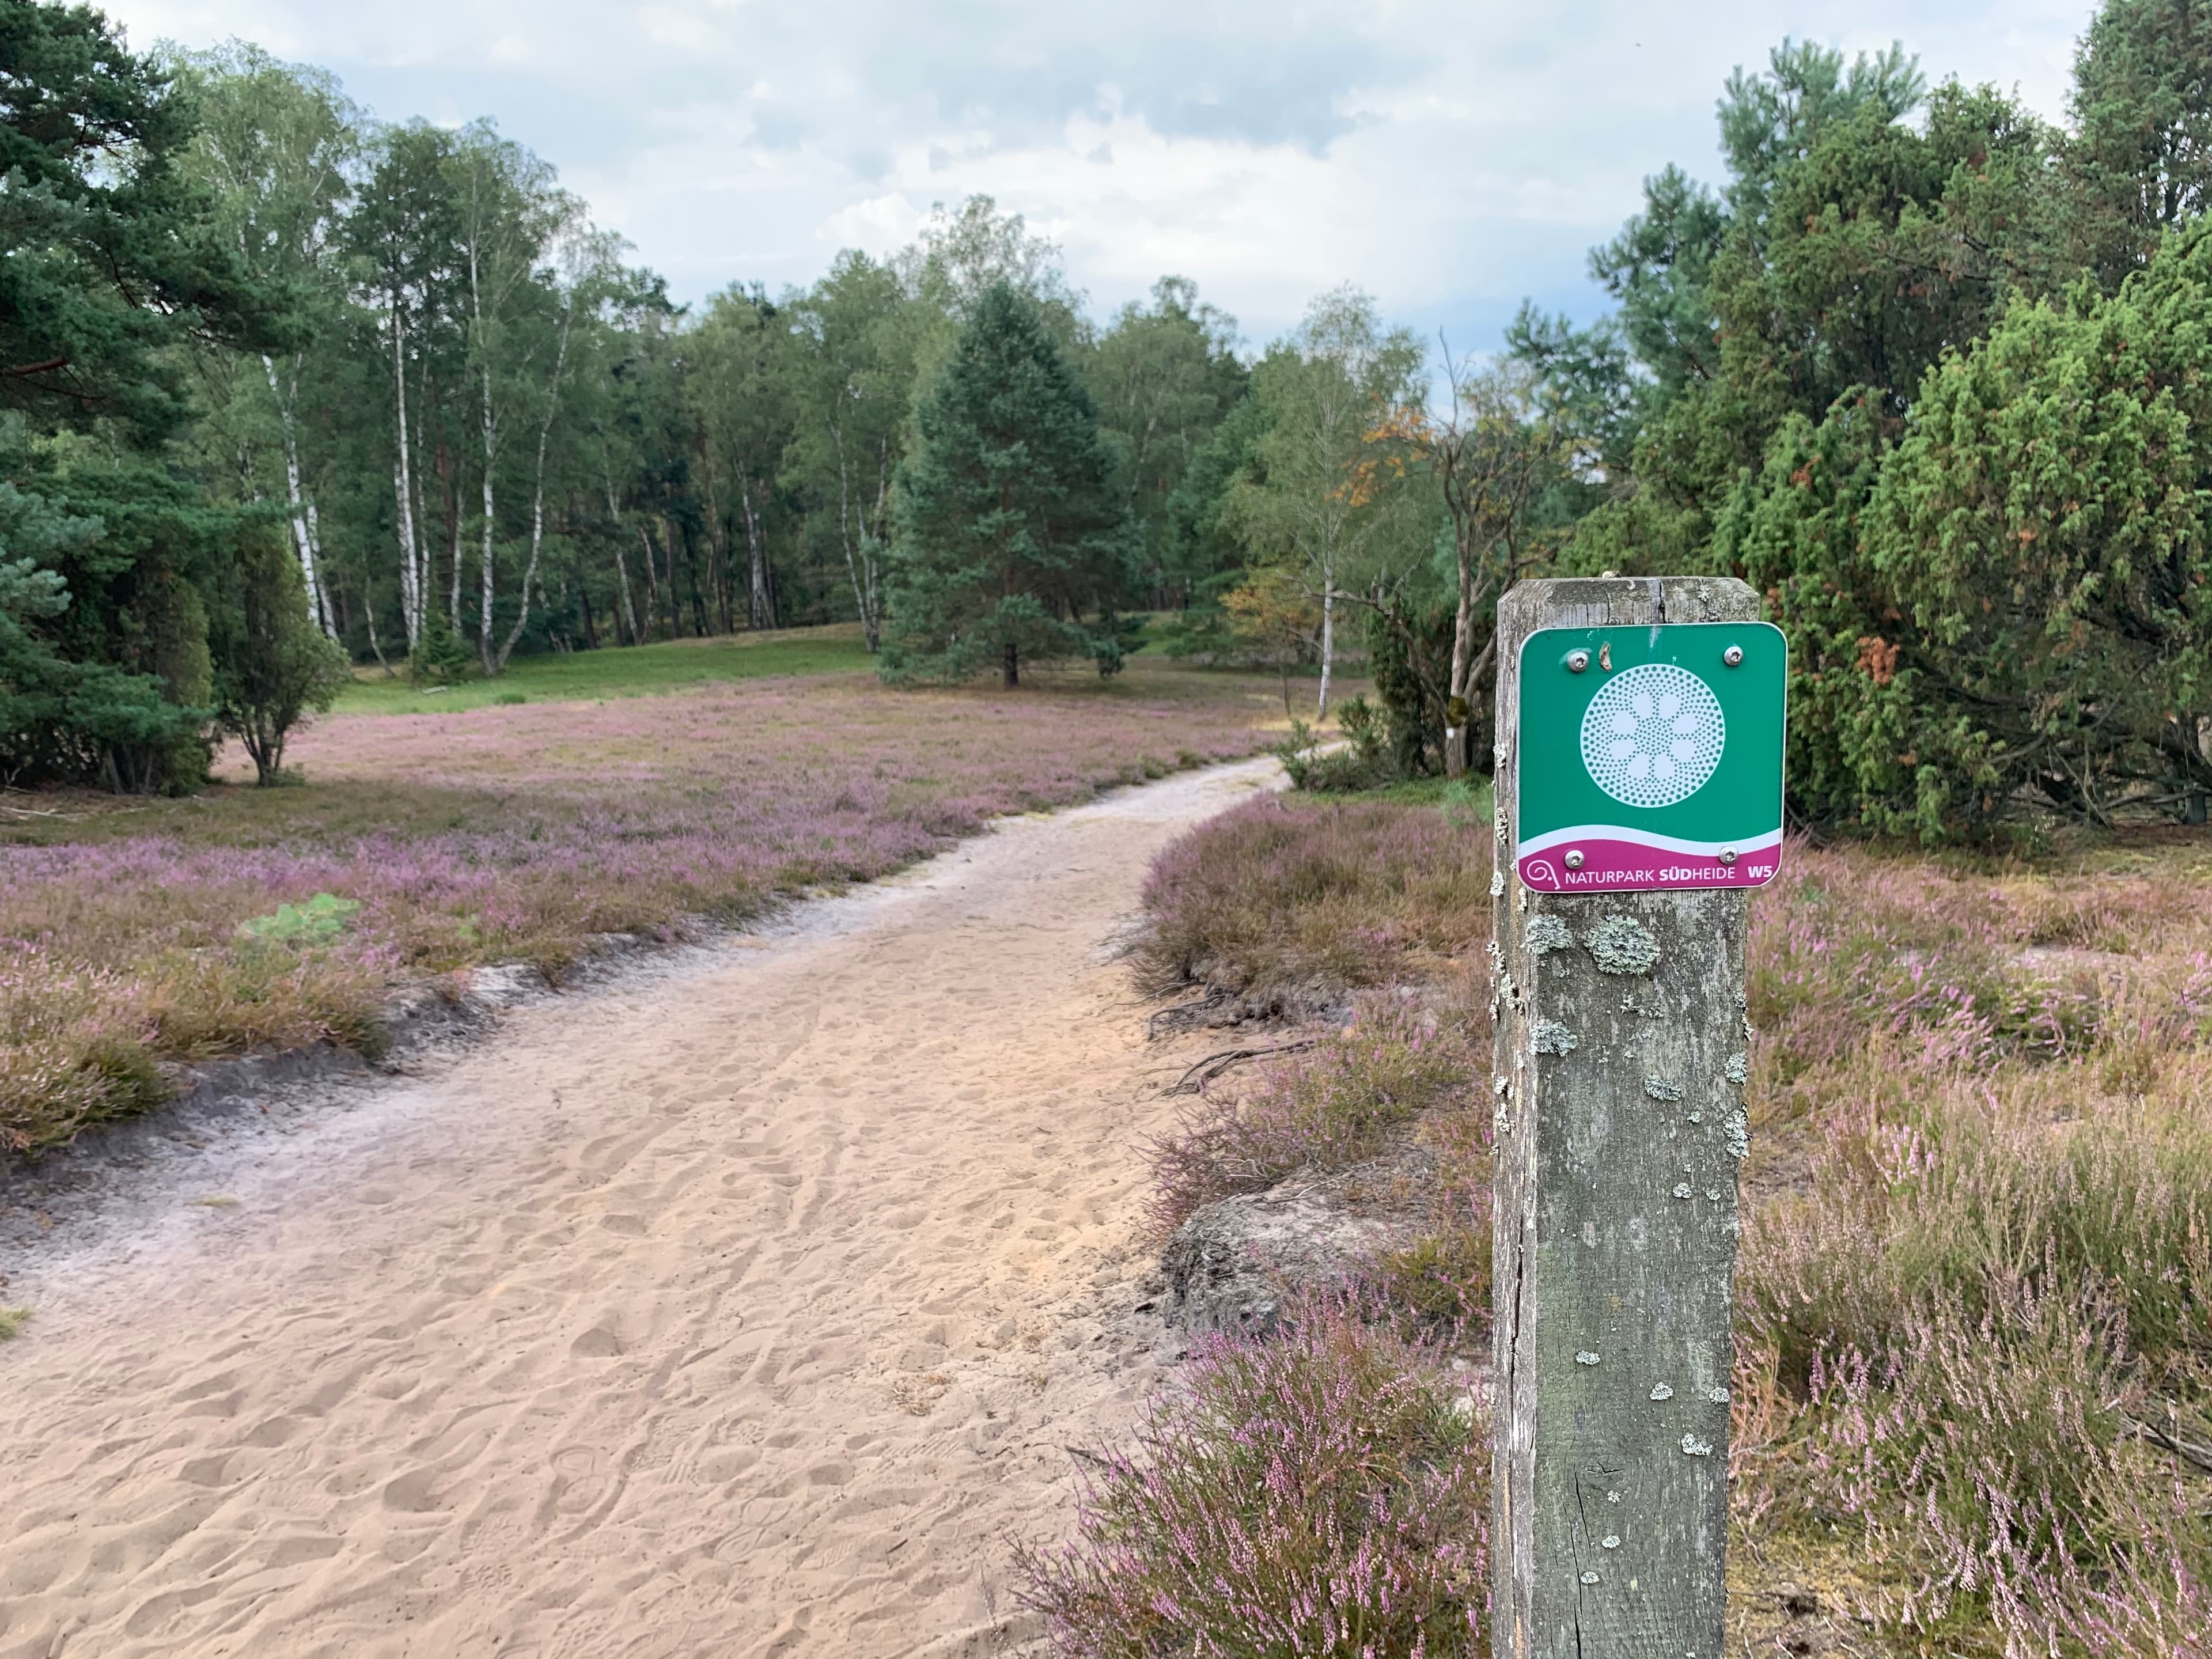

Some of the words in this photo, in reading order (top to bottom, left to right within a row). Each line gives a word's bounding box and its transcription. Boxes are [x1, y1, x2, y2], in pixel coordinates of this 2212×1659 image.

[1565, 869, 1654, 884] NATURPARK
[1659, 865, 1736, 881] SÜDHEIDE
[1748, 865, 1772, 877] W5
